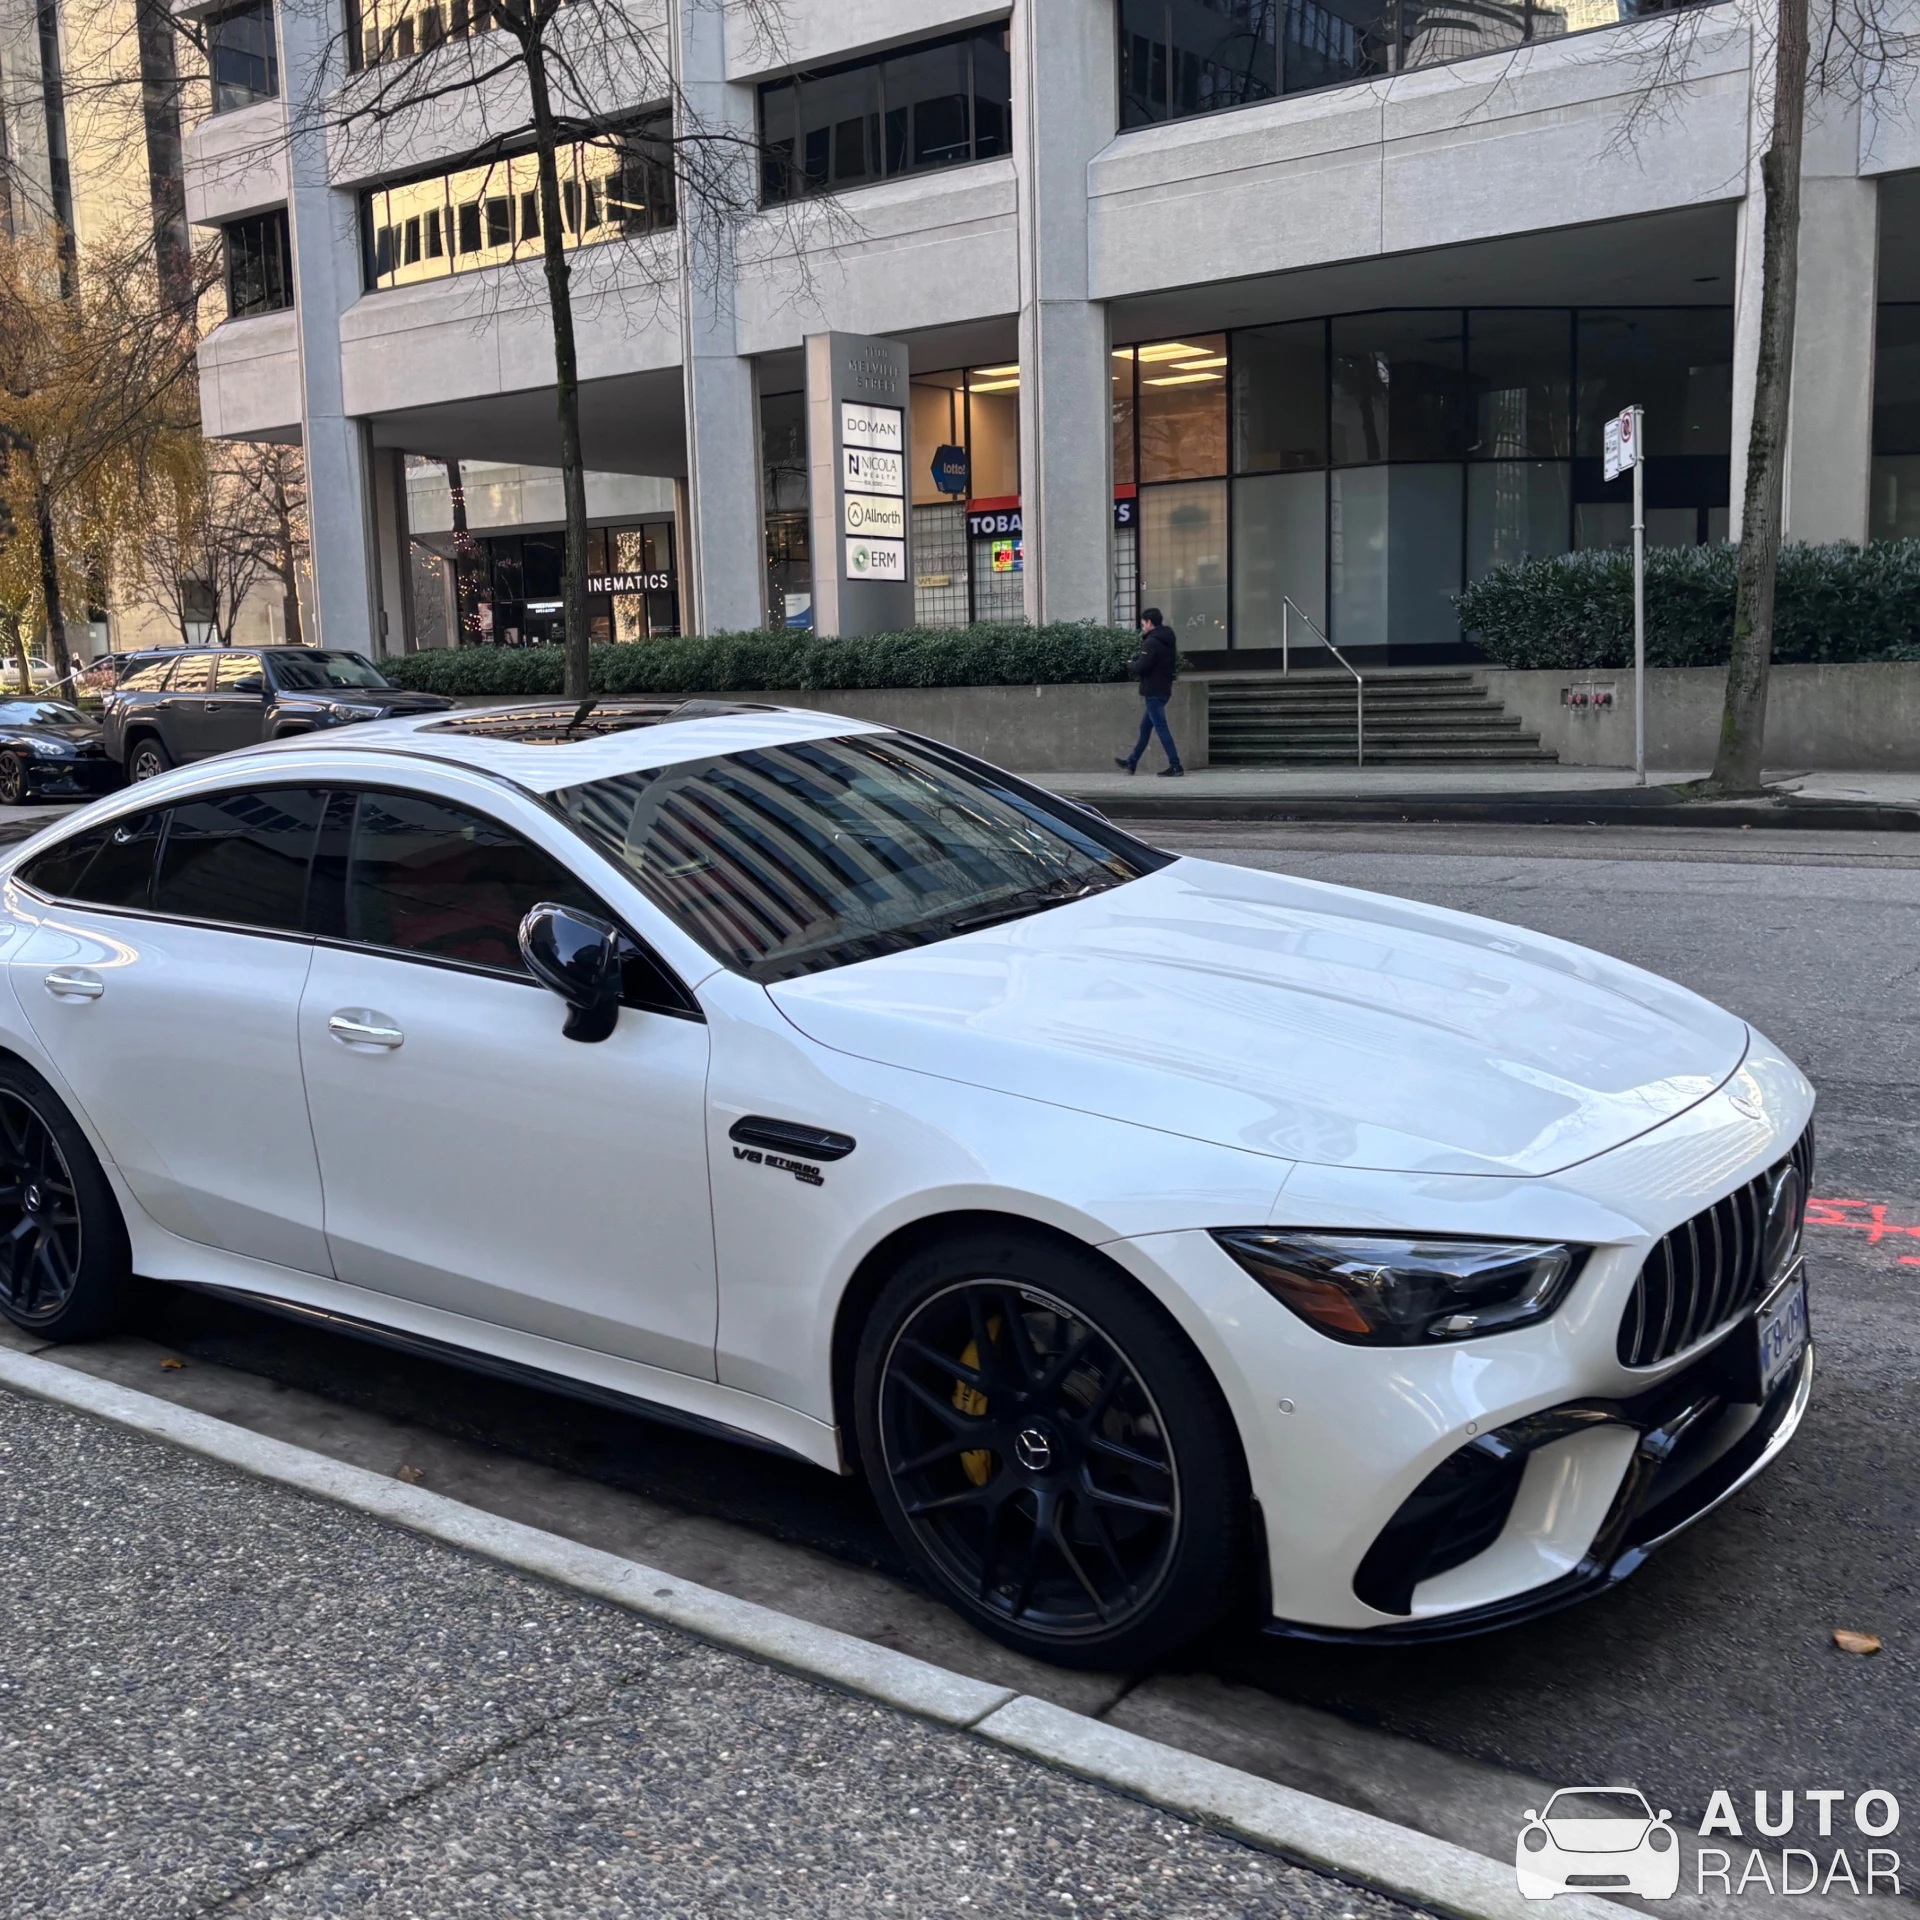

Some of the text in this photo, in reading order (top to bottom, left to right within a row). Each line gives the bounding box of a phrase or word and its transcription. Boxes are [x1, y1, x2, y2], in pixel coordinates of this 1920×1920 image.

[847, 418, 897, 436] DOMAN
[861, 456, 898, 473] NICOLA
[863, 471, 896, 480] WEALTH
[864, 508, 901, 524] Allnorth
[970, 515, 1023, 534] TOBA
[871, 551, 897, 569] ERM
[587, 574, 669, 593] INEMATICS
